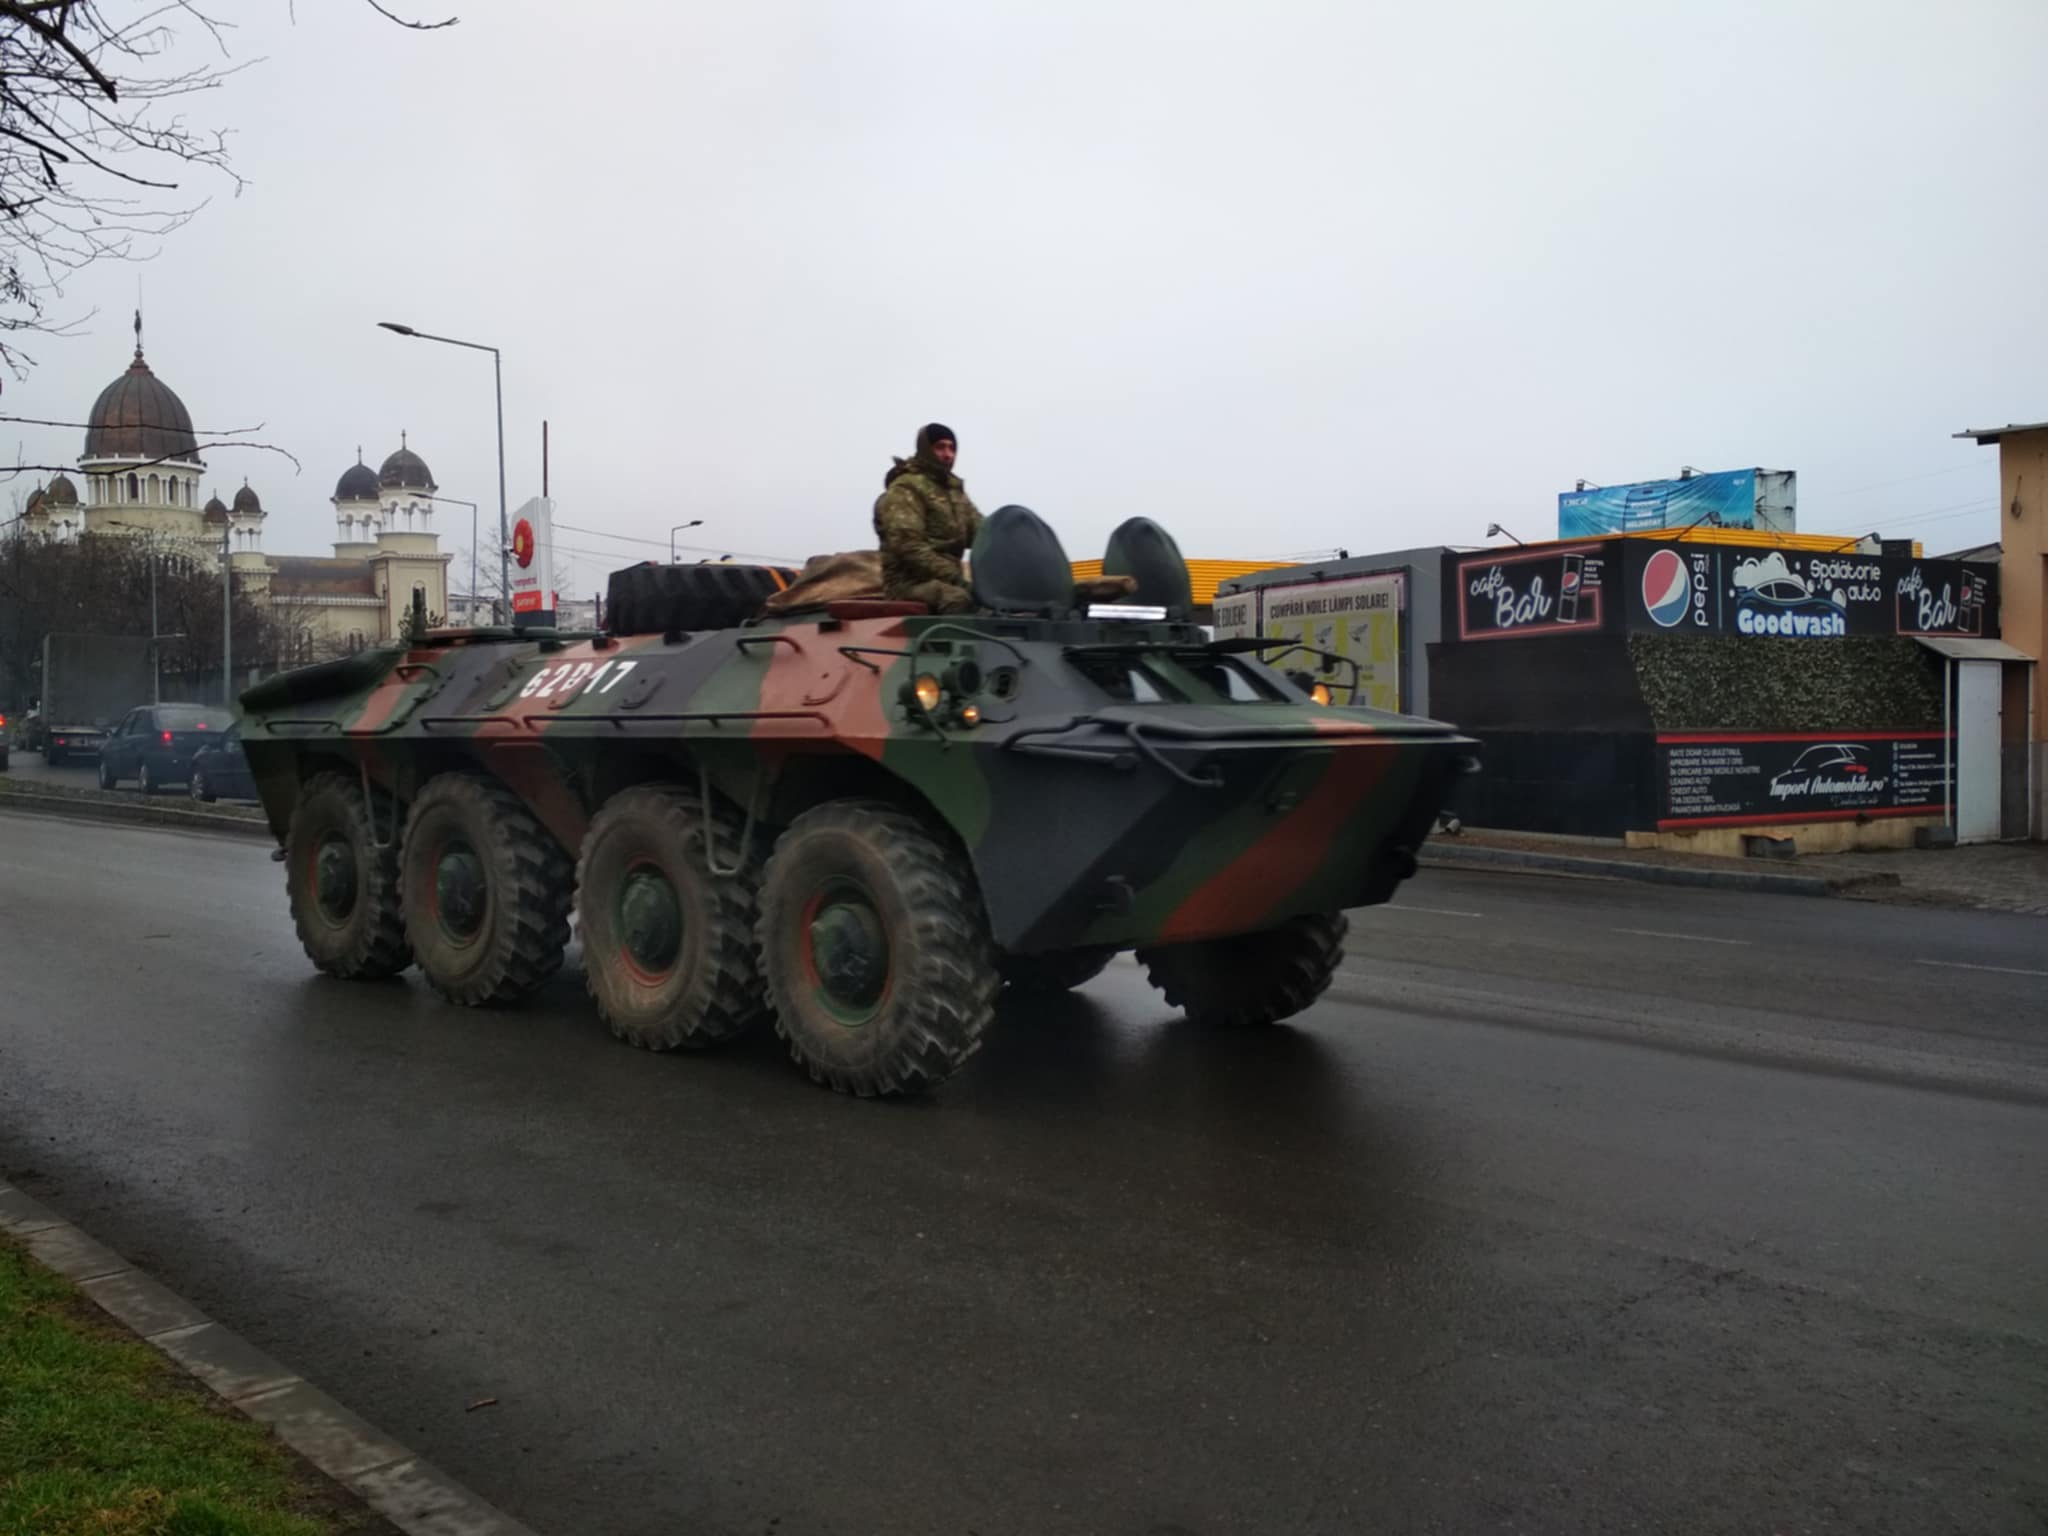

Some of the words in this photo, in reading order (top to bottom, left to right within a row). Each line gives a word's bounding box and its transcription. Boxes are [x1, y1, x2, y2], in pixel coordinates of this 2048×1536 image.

[1496, 576, 1552, 628] Bar
[1690, 553, 1709, 626] pepsi
[1848, 585, 1882, 601] auto
[1919, 583, 1958, 631] Bar
[1738, 608, 1845, 637] Goodwash
[1769, 777, 1810, 801] Import
